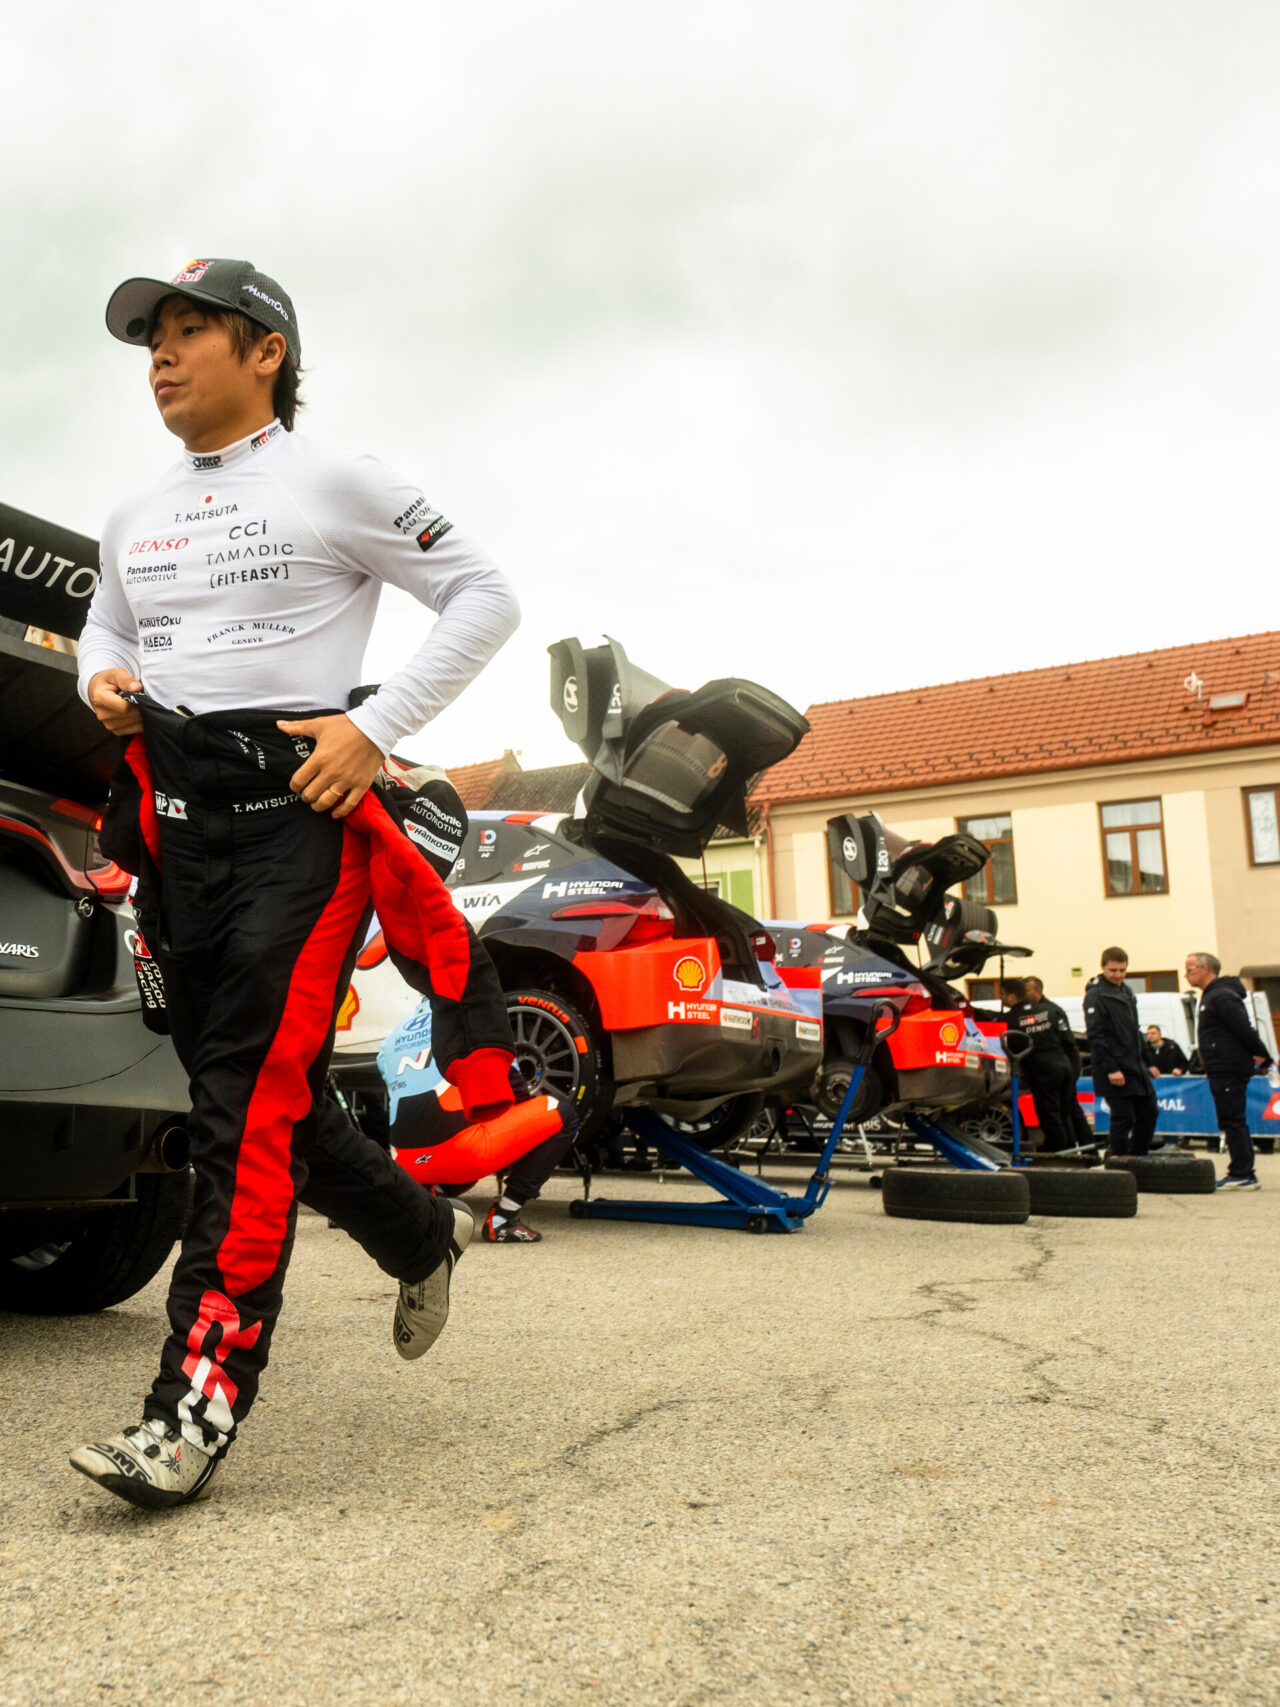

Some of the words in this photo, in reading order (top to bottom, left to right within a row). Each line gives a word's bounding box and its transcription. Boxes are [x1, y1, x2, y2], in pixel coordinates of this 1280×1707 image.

[175, 513, 182, 523] T.
[185, 504, 238, 521] KATSUTA
[129, 537, 189, 555] DENSO
[206, 543, 294, 565] TAMADIC
[127, 562, 177, 576] Panasonic
[126, 573, 178, 585] AUTOMOTIVE
[207, 623, 245, 643] FRANCK
[252, 622, 296, 635] MULLER
[231, 636, 264, 645] GENEVE
[233, 803, 242, 813] T.
[409, 803, 462, 837] AUTOMOTIVE
[567, 887, 608, 896] STEEL
[569, 880, 624, 889] HYUNDAI
[395, 1031, 432, 1046] HYUND
